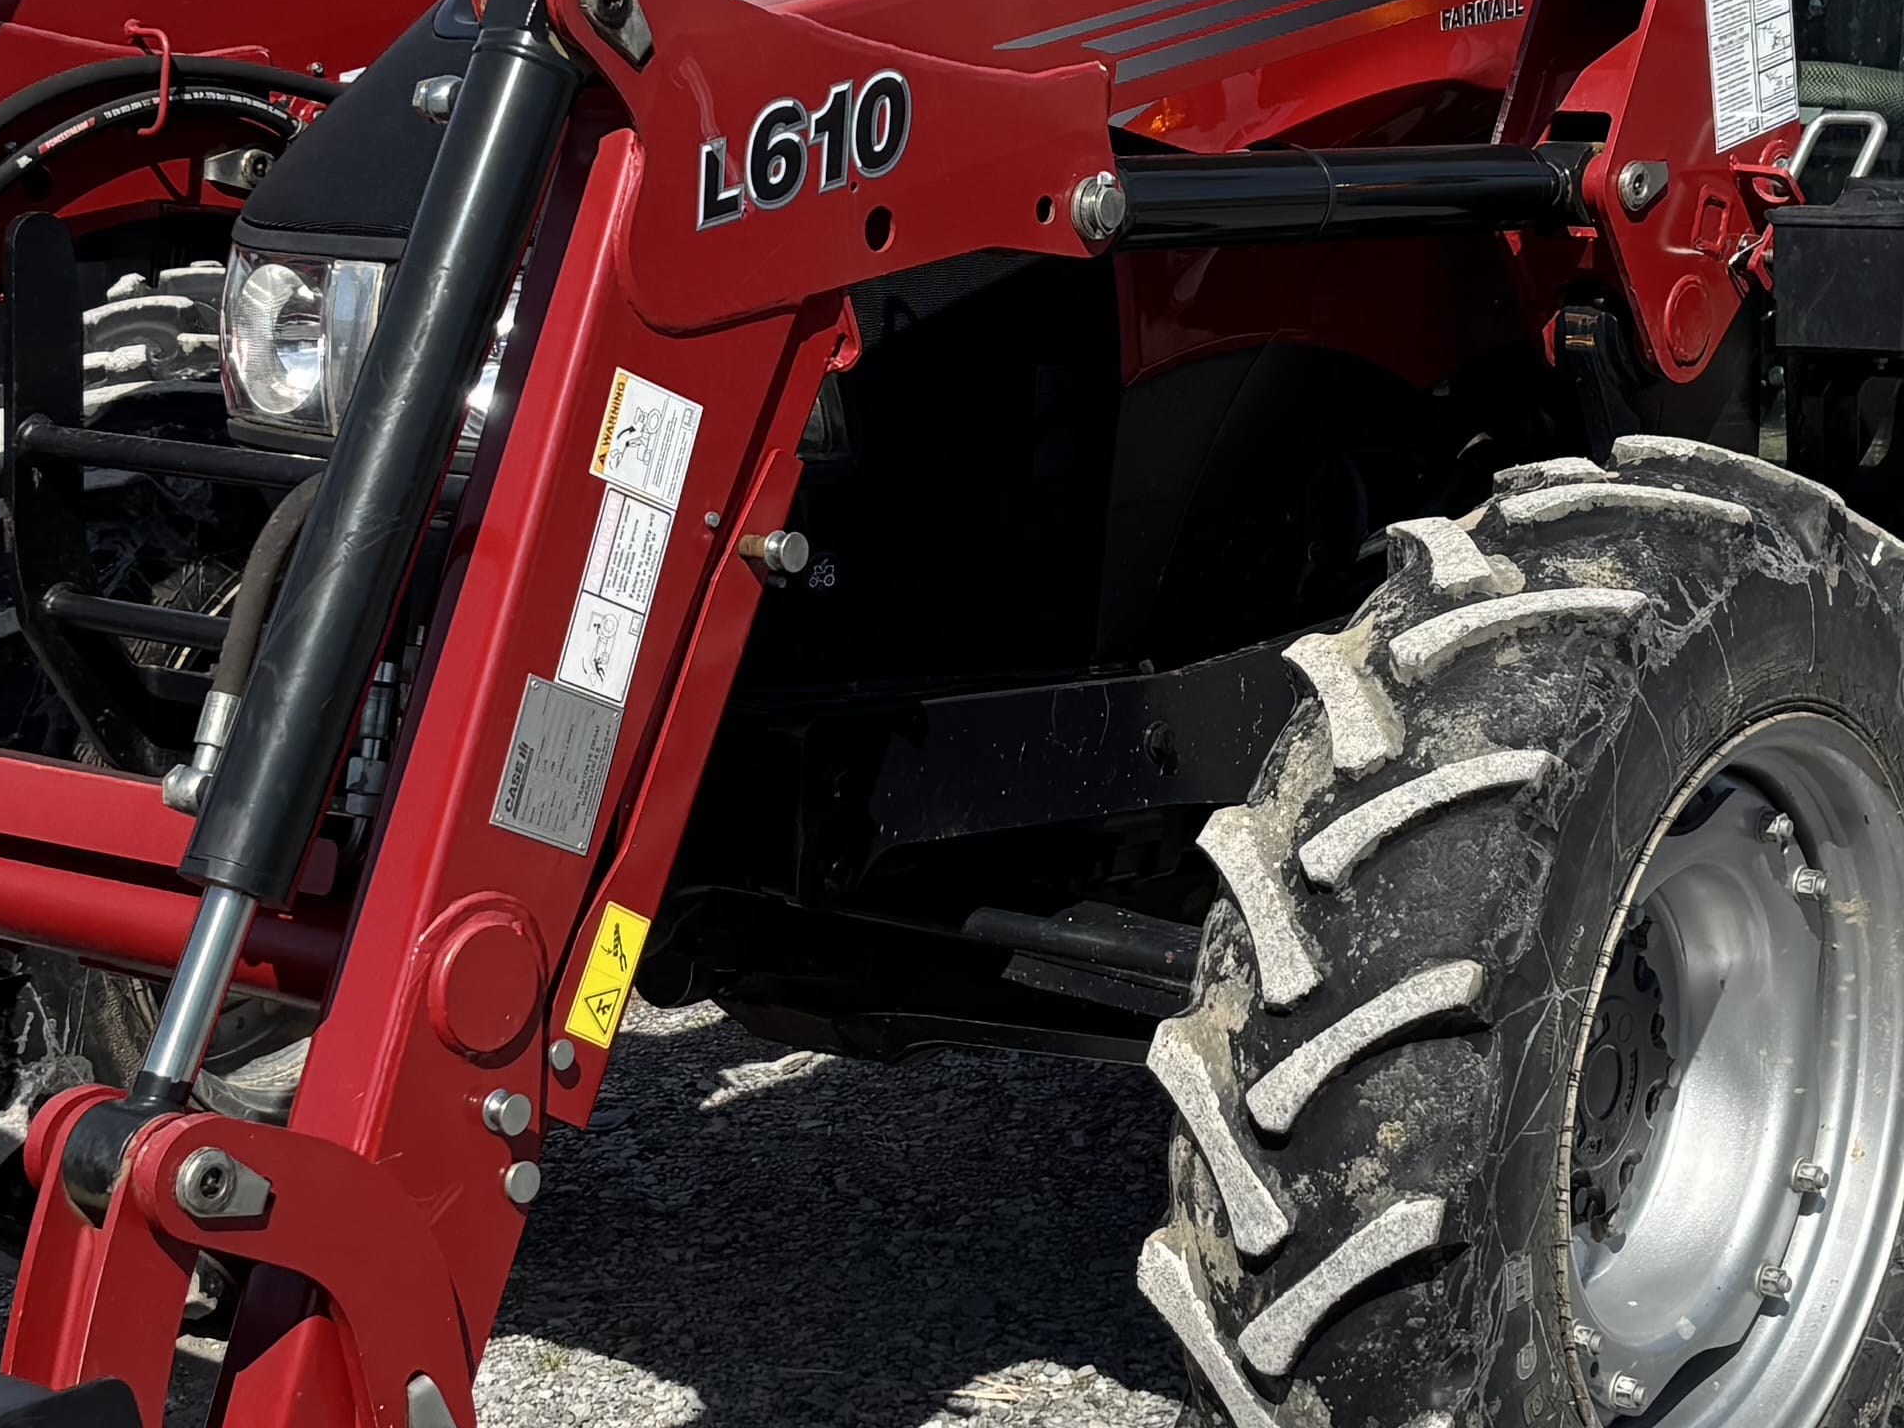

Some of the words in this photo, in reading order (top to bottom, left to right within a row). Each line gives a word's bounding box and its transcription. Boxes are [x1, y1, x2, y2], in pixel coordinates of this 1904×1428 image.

[696, 68, 911, 231] L610
[602, 382, 625, 446] WARNING
[505, 759, 525, 813] CASE
